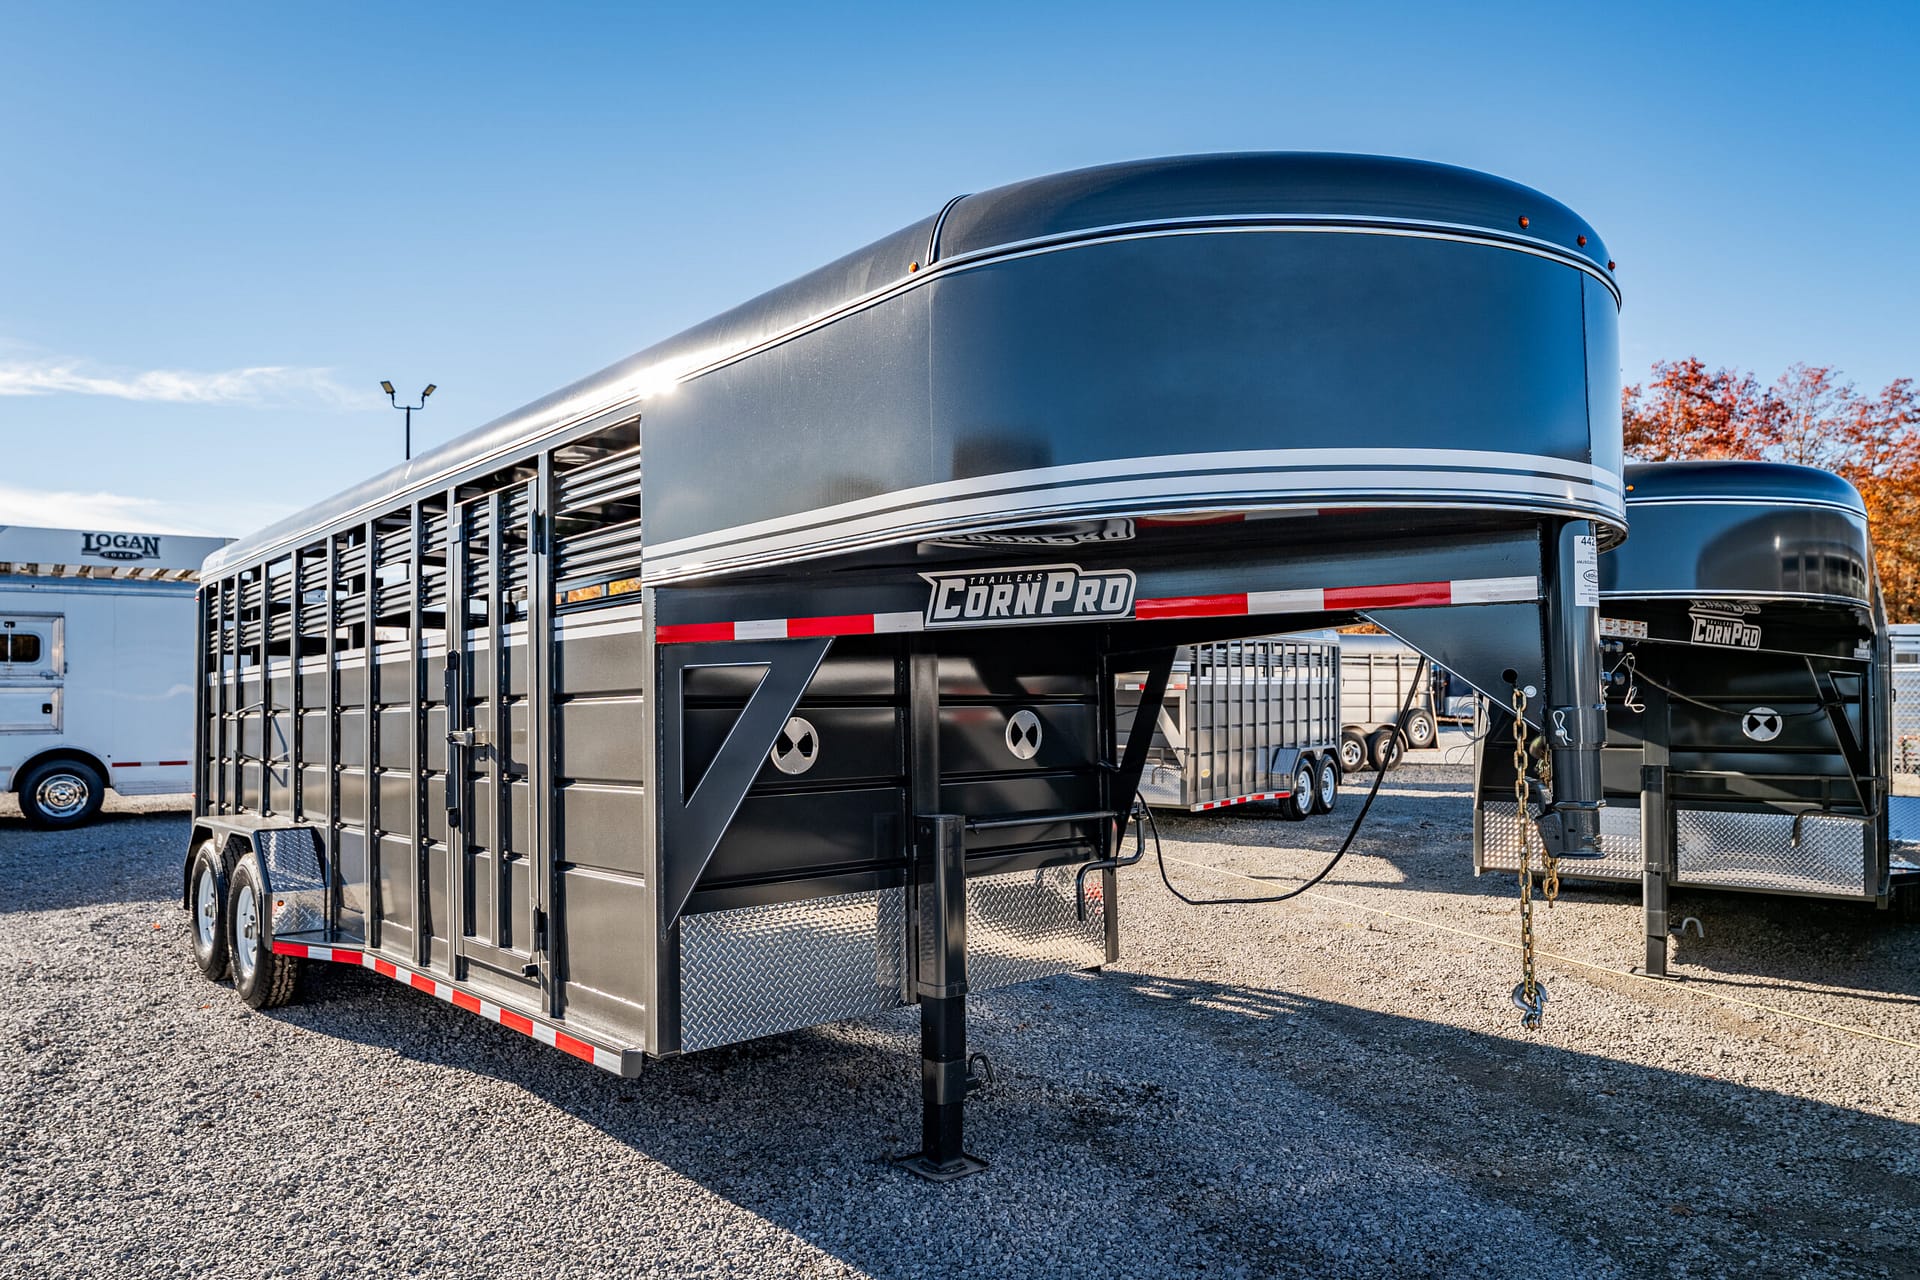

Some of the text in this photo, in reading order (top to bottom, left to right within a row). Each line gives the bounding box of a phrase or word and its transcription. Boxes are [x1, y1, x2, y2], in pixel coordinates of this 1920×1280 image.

[82, 533, 160, 556] LOGAN
[970, 573, 1043, 585] TRAILERS
[933, 572, 1129, 619] CORNPRO
[1694, 618, 1759, 647] CORNPRO
